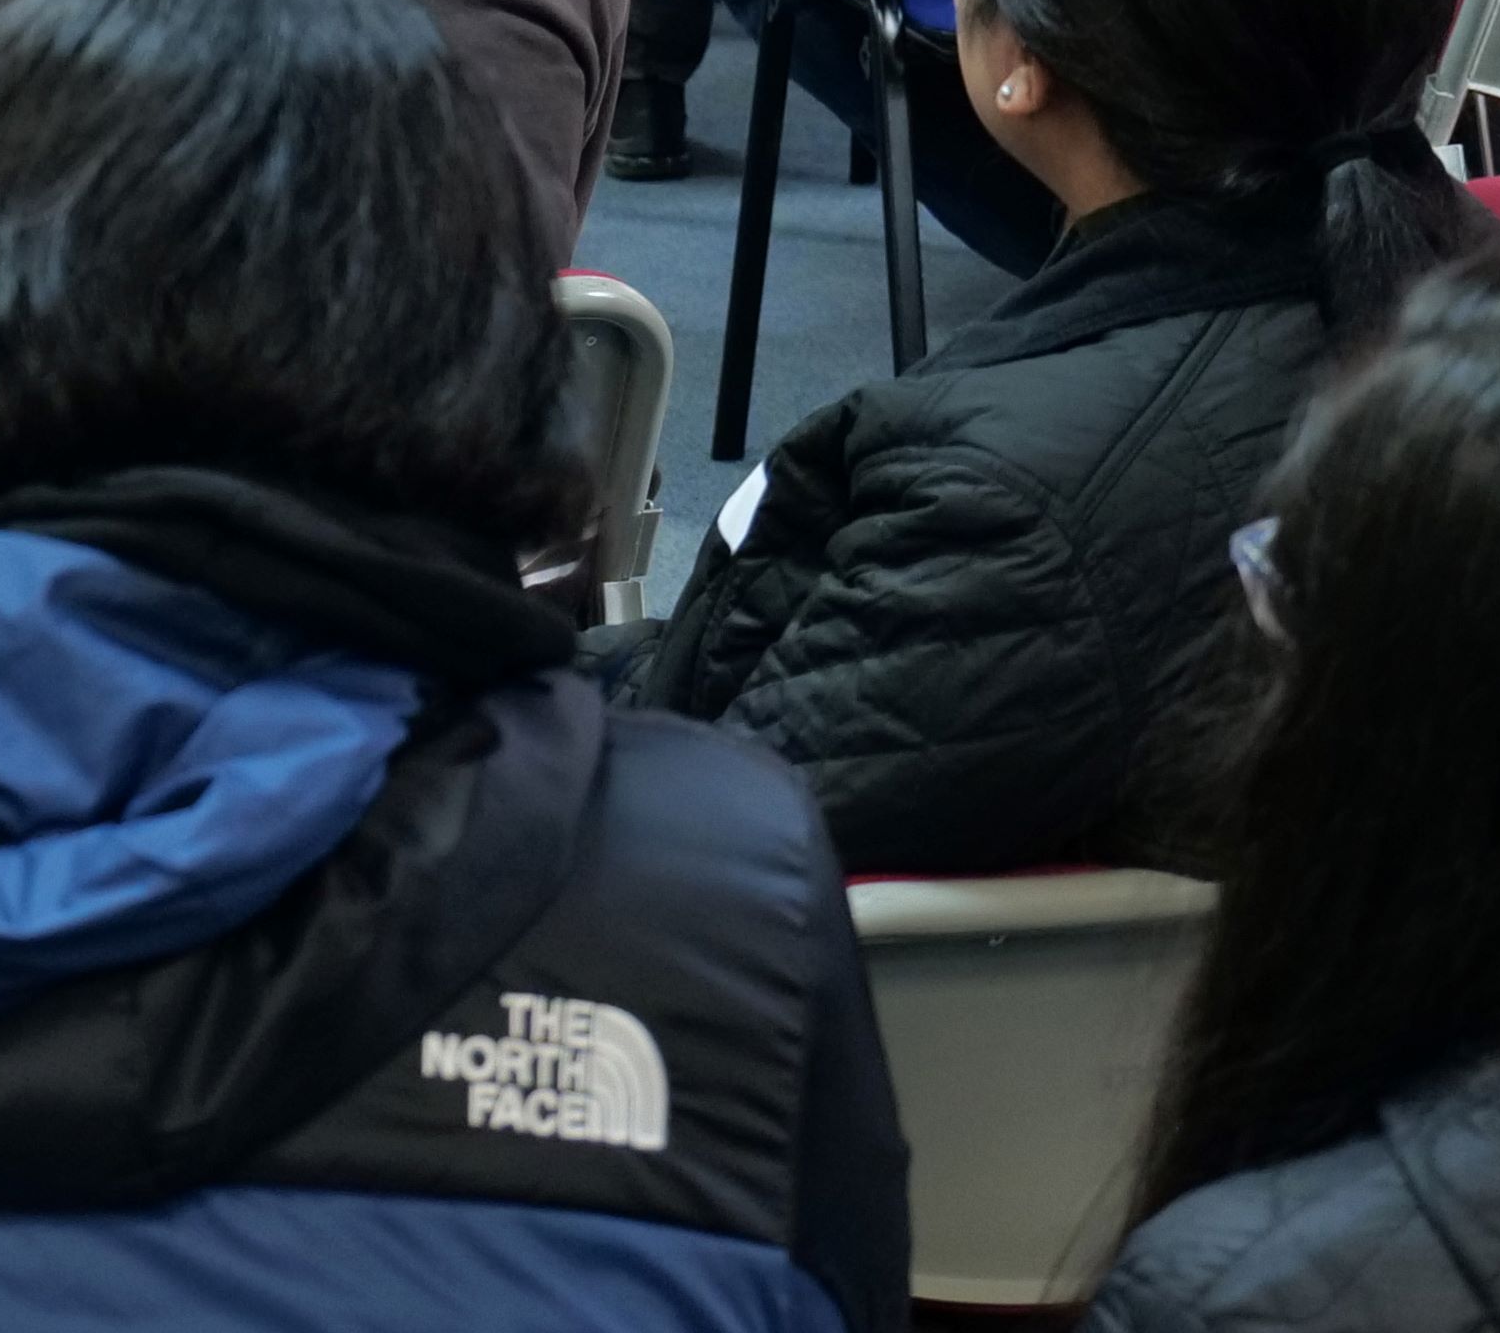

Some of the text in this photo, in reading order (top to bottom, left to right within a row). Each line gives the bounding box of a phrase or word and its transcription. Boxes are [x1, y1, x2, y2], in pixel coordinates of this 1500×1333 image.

[501, 992, 594, 1048] THE
[421, 1031, 589, 1092] NORTH
[468, 1082, 591, 1139] FACE
